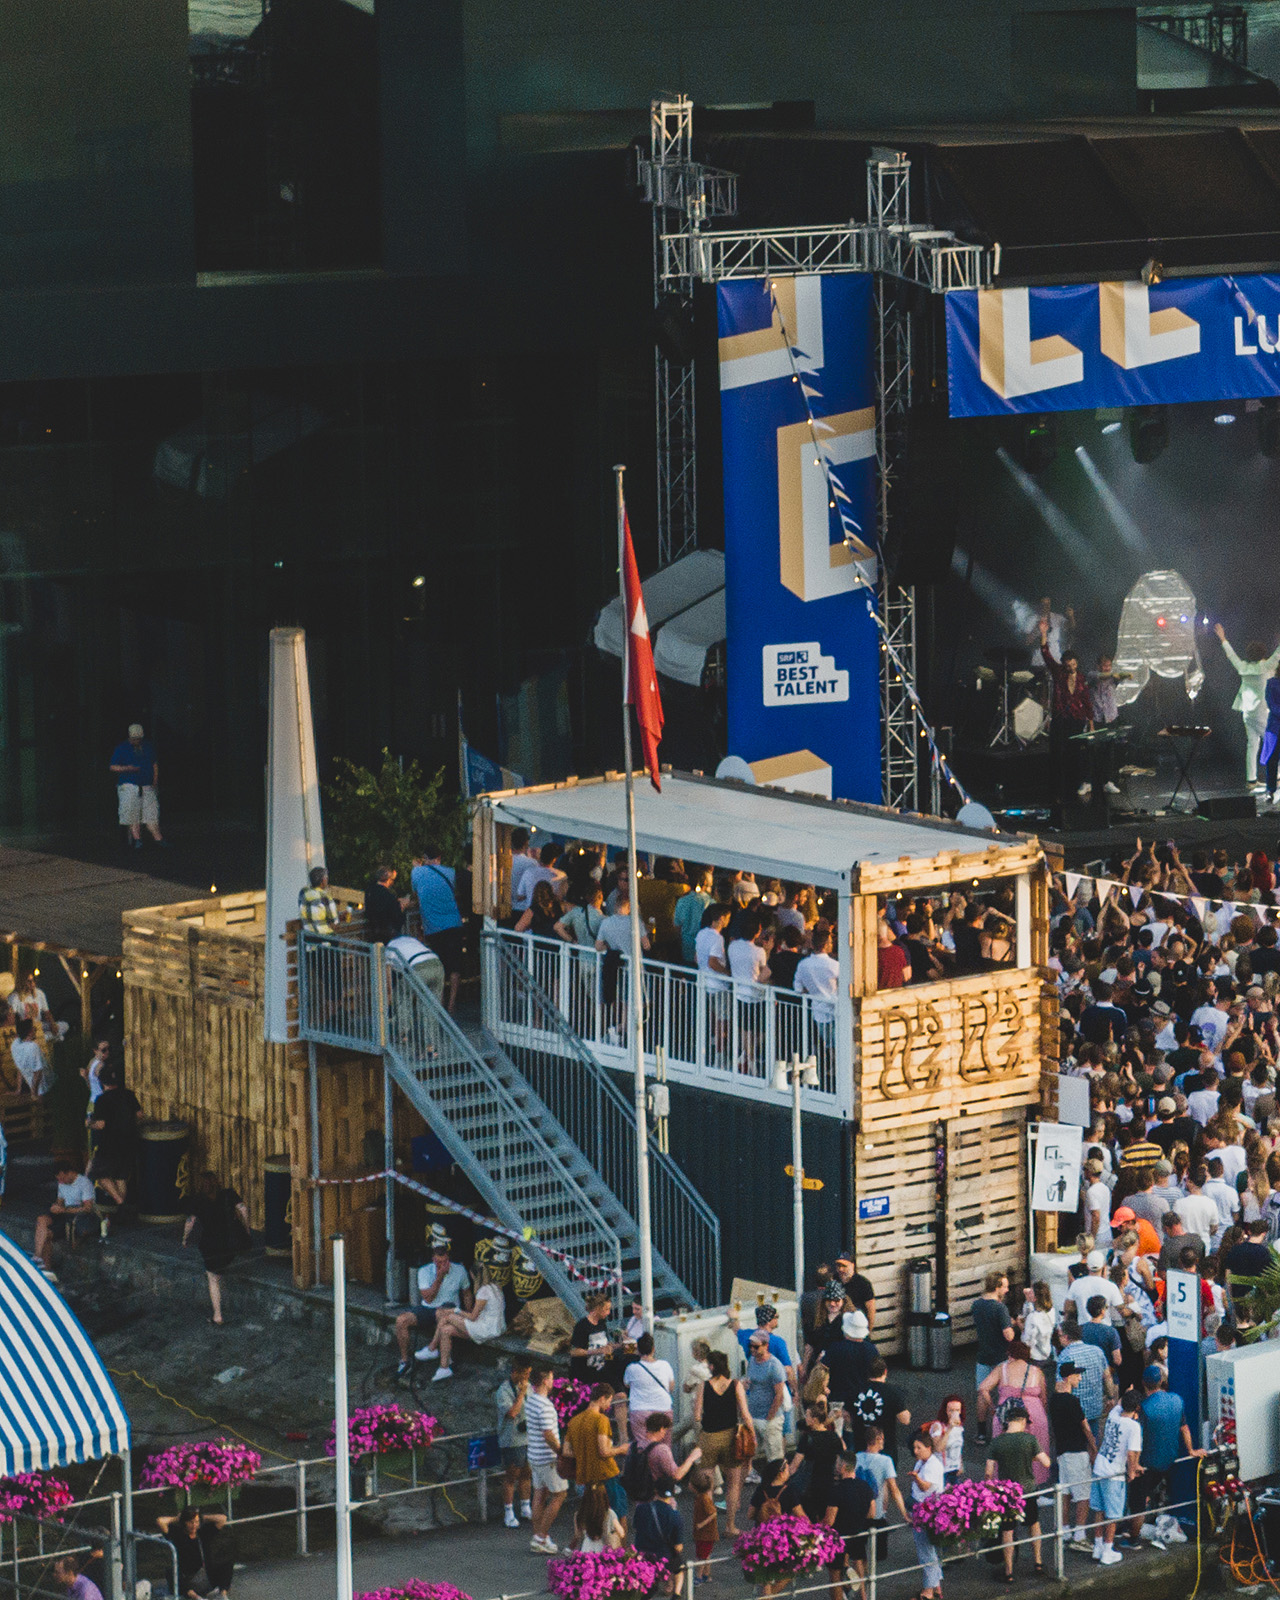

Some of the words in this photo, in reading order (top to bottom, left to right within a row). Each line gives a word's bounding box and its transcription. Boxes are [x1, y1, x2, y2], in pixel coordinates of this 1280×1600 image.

[777, 666, 819, 681] BEST
[774, 679, 838, 696] TALENT
[1178, 1282, 1186, 1302] 5
